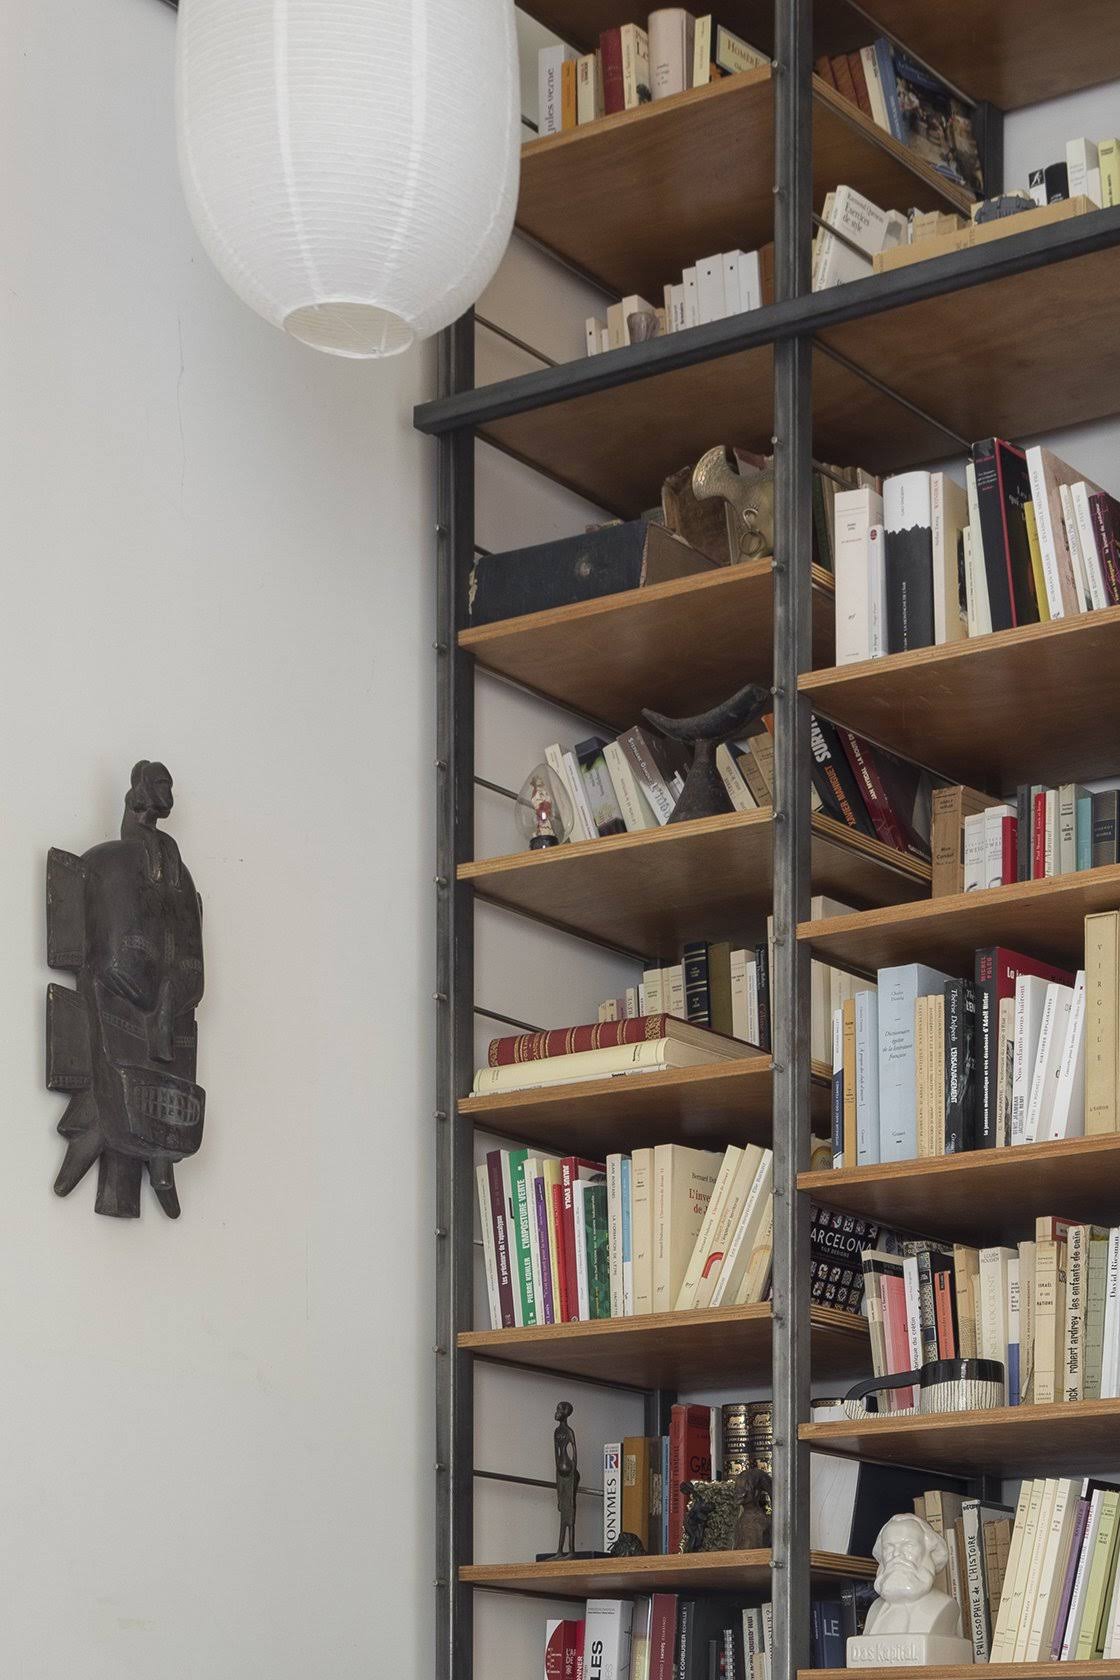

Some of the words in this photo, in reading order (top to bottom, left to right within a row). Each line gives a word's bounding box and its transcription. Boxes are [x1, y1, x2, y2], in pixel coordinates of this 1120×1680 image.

[547, 67, 556, 97] verne
[517, 1179, 527, 1201] VERTE
[518, 1202, 530, 1249] L'IMPOSTURE
[1070, 1230, 1081, 1250] caïn
[1070, 1251, 1080, 1262] de
[1069, 1263, 1081, 1295] enfants
[1069, 1298, 1080, 1311] les
[1069, 1315, 1081, 1345] ardrey
[1067, 1347, 1079, 1374] robert
[967, 1535, 979, 1582] L'HISTOIRE
[971, 1586, 980, 1596] de
[973, 1600, 986, 1656] PHILOSOPHIE
